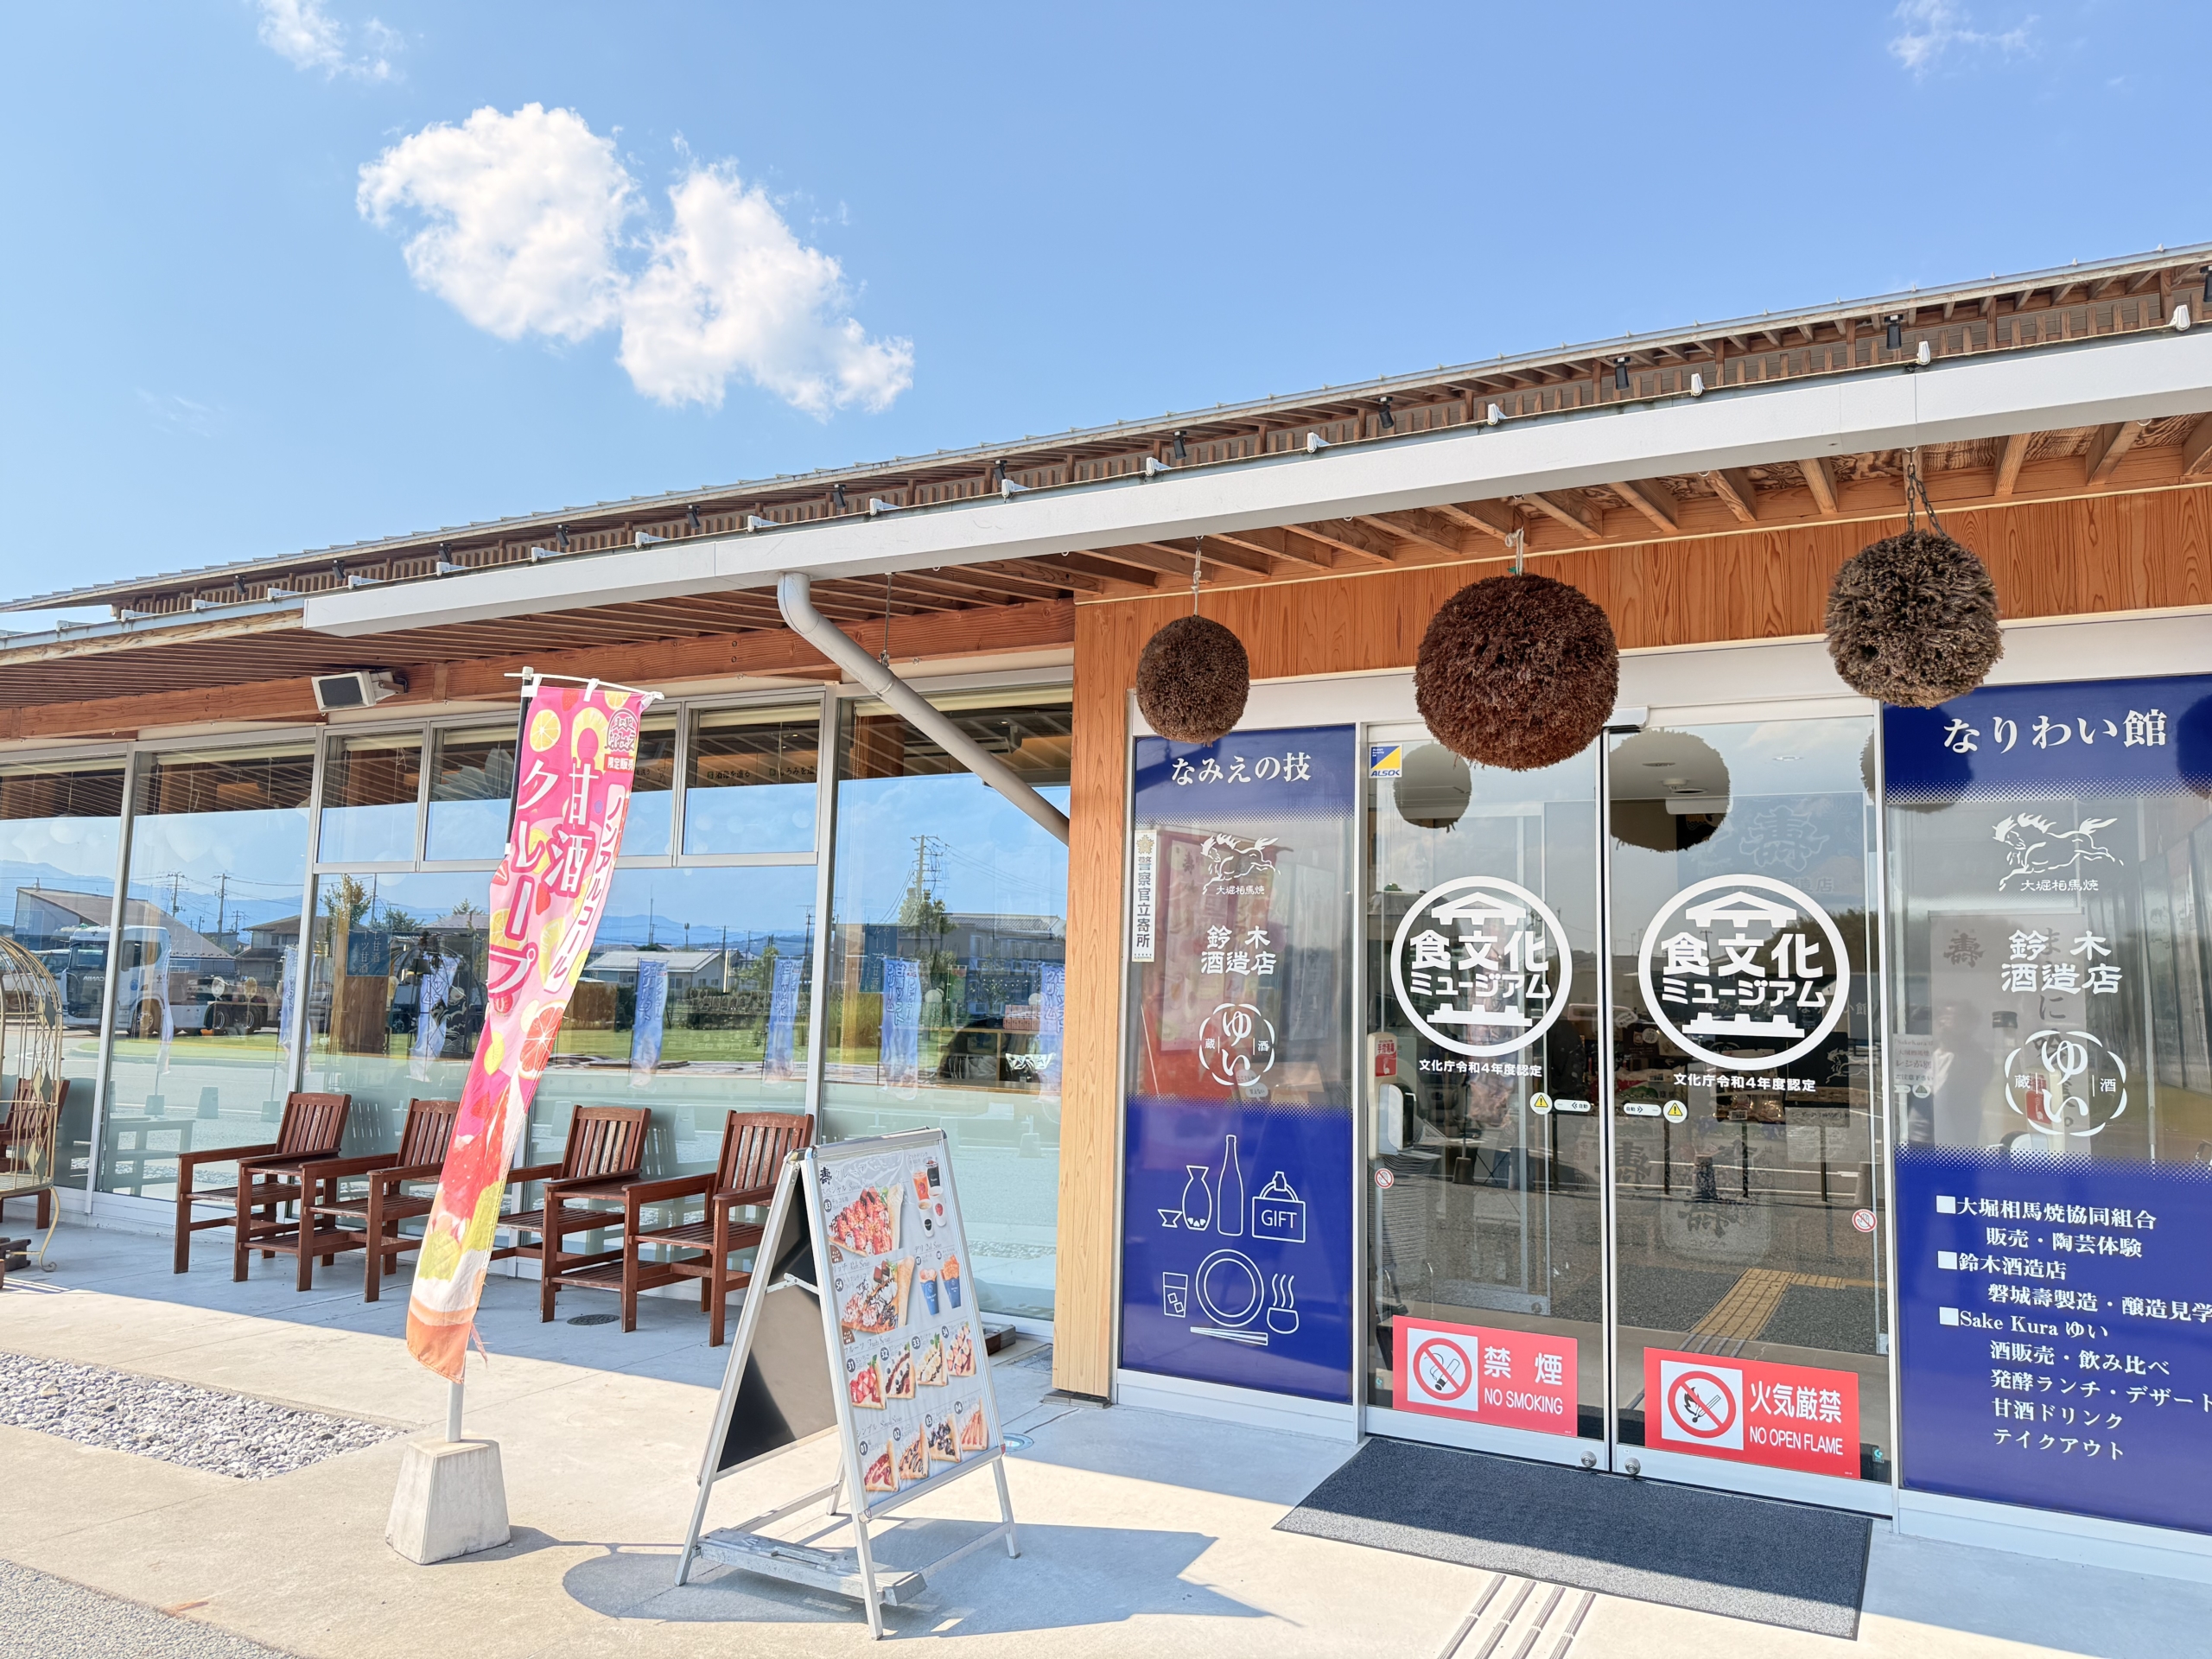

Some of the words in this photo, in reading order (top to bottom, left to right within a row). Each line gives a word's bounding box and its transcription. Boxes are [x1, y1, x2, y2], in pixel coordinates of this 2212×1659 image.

[1942, 709, 2168, 754] なりわい館
[1172, 752, 1312, 785] なみえの技
[544, 762, 600, 893] 甘酒
[488, 759, 559, 993] クレープ
[550, 795, 623, 977] ノンアルコール
[1215, 885, 1265, 896] 大堀相馬焼
[2020, 878, 2100, 893] 大堀相馬焼
[1136, 856, 1152, 949] 警察官立寄所
[1206, 925, 1271, 950] 鈴木
[1408, 928, 1550, 973] 食文化
[2008, 929, 2112, 962] 鈴木
[1200, 951, 1277, 976] 酒造店
[1661, 931, 1824, 979] 食文化
[1409, 971, 1553, 1000] ミュージアム
[1662, 977, 1827, 1009] ミュージアム
[2001, 963, 2123, 995] 酒造店
[1221, 1009, 1252, 1077] ゆい
[1257, 1039, 1270, 1052] 酒
[1419, 1058, 1543, 1077] 文化庁令和4年度認定
[1673, 1072, 1817, 1093] 文化庁令和4年度認定
[2042, 1038, 2090, 1124] ゆい
[2100, 1077, 2117, 1093] 酒
[1261, 1209, 1298, 1229] GIFT
[1956, 1196, 2158, 1230] 大堀相馬焼協同組合
[1986, 1226, 2144, 1259] 販売・陶芸体験
[1958, 1252, 2068, 1281] 鈴木酒造店
[1988, 1283, 2212, 1324] 磐城壽製造・醸造見学
[1960, 1311, 2004, 1331] Sake
[2010, 1315, 2059, 1337] Kura
[2065, 1320, 2109, 1339] ゆい
[1484, 1345, 1563, 1386] 禁煙
[1990, 1339, 2171, 1376] 酒販売・飲み比べ
[1484, 1388, 1503, 1408] NO
[1505, 1393, 1563, 1416] SMOKING
[1749, 1380, 1842, 1424] 火気厳禁
[1990, 1369, 2212, 1413] 発酵ランチ・デザート
[1992, 1397, 2124, 1430] 甘酒ドリンク
[1749, 1427, 1767, 1445] NO
[1769, 1428, 1801, 1450] OPEN
[1804, 1433, 1844, 1456] FLAME
[1993, 1427, 2125, 1461] テイクアウト
